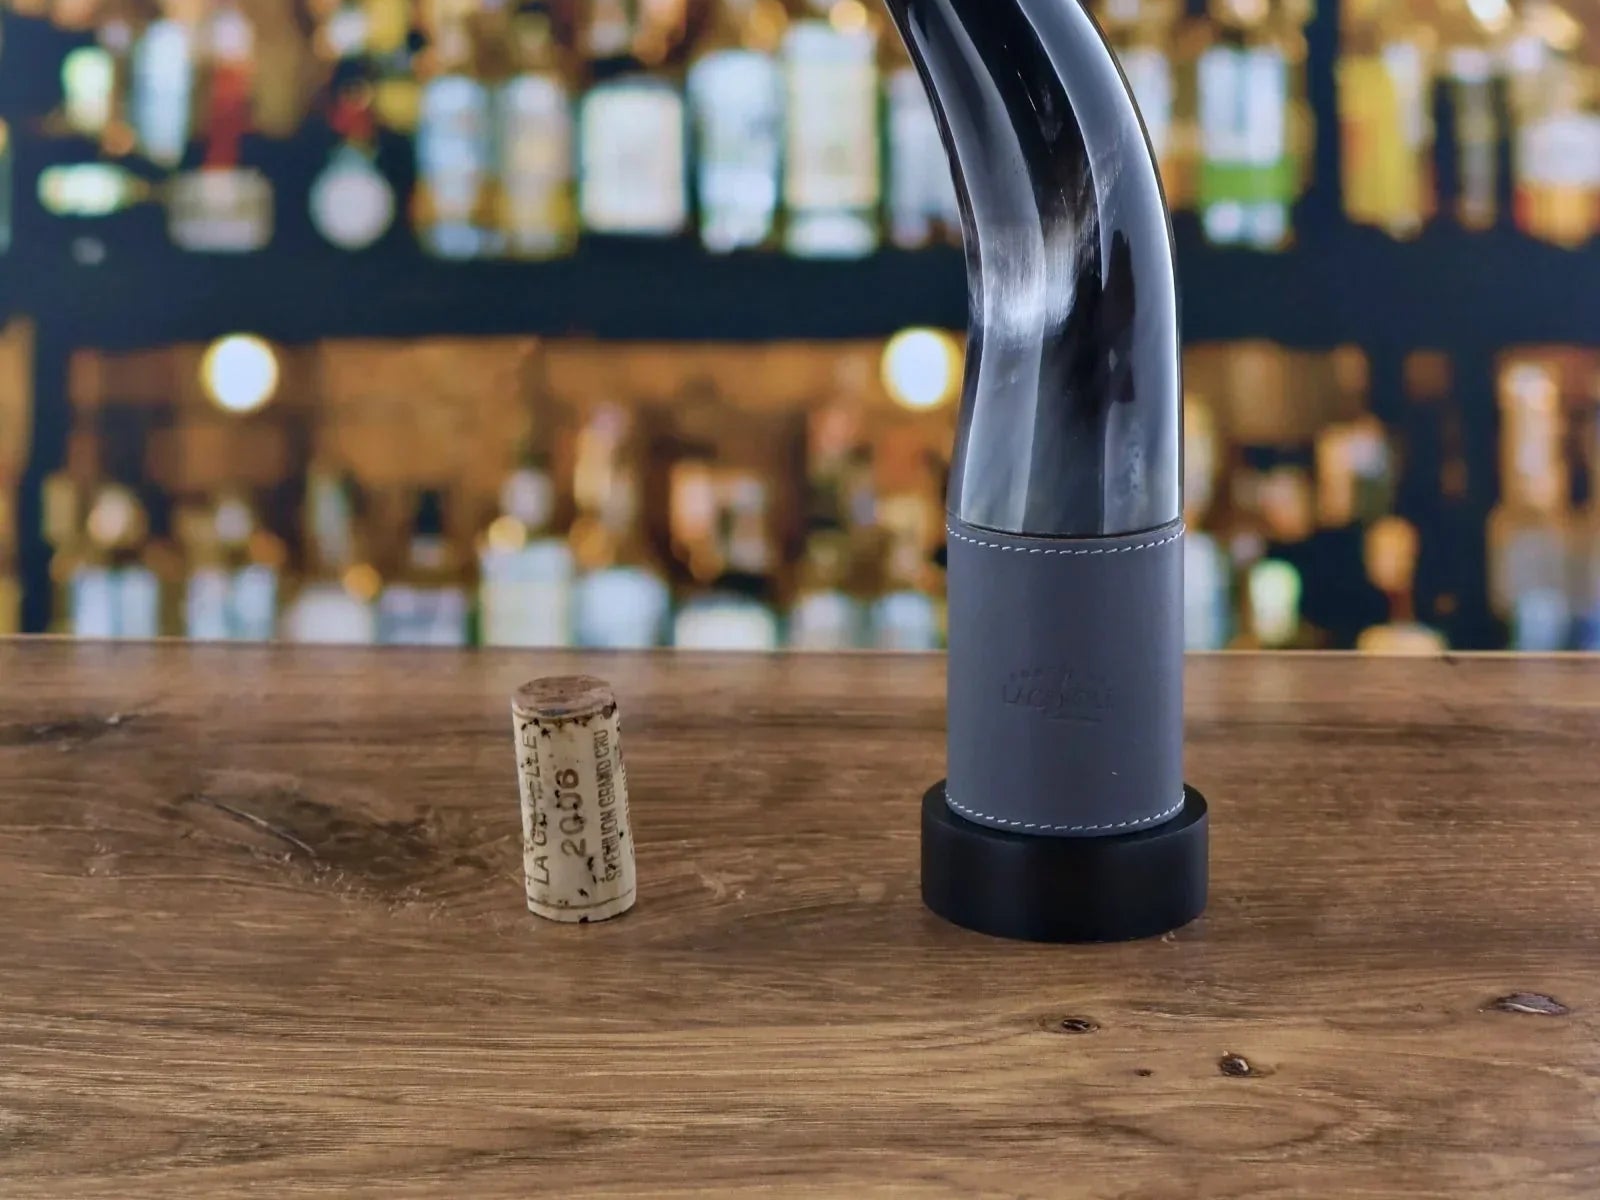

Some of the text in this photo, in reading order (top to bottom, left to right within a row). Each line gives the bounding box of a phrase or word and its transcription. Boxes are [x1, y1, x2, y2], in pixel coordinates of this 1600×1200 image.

[593, 729, 610, 760] CRU
[596, 760, 616, 809] GRAND
[555, 768, 587, 858] 2006
[533, 855, 550, 885] LA
